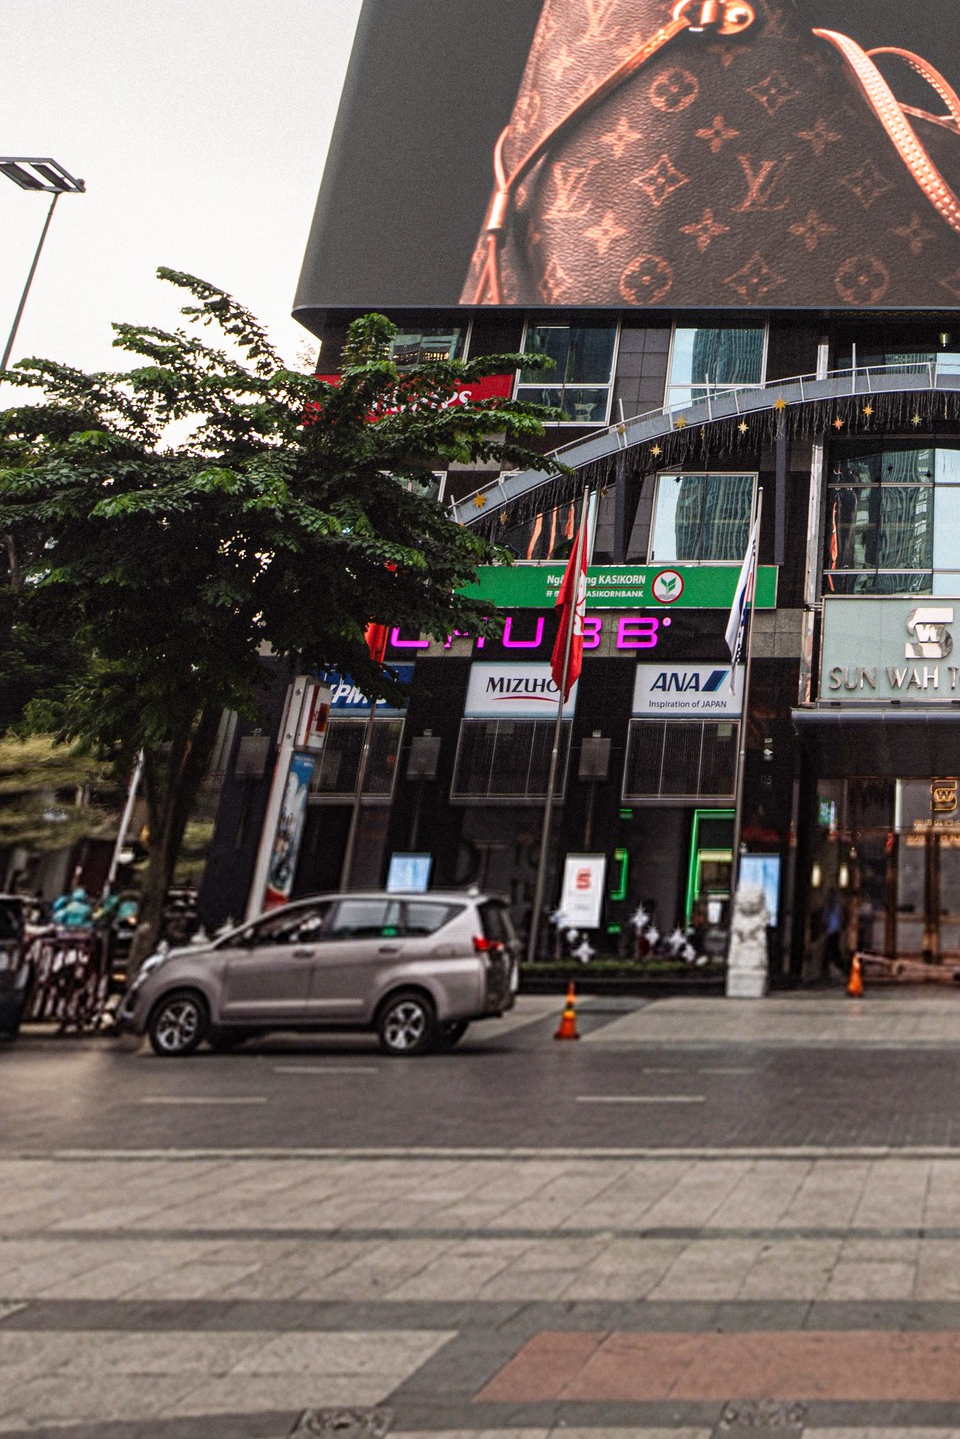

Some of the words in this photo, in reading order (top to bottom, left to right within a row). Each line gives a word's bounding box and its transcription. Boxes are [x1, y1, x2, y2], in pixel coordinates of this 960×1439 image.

[598, 574, 646, 584] KASIKORN
[586, 590, 644, 598] ASIKORNBANK
[650, 672, 700, 692] ANA
[829, 666, 877, 690] SUN
[886, 666, 939, 690] WAH
[486, 677, 561, 693] MIZUHO
[649, 700, 690, 709] Inspiration
[691, 700, 700, 708] of
